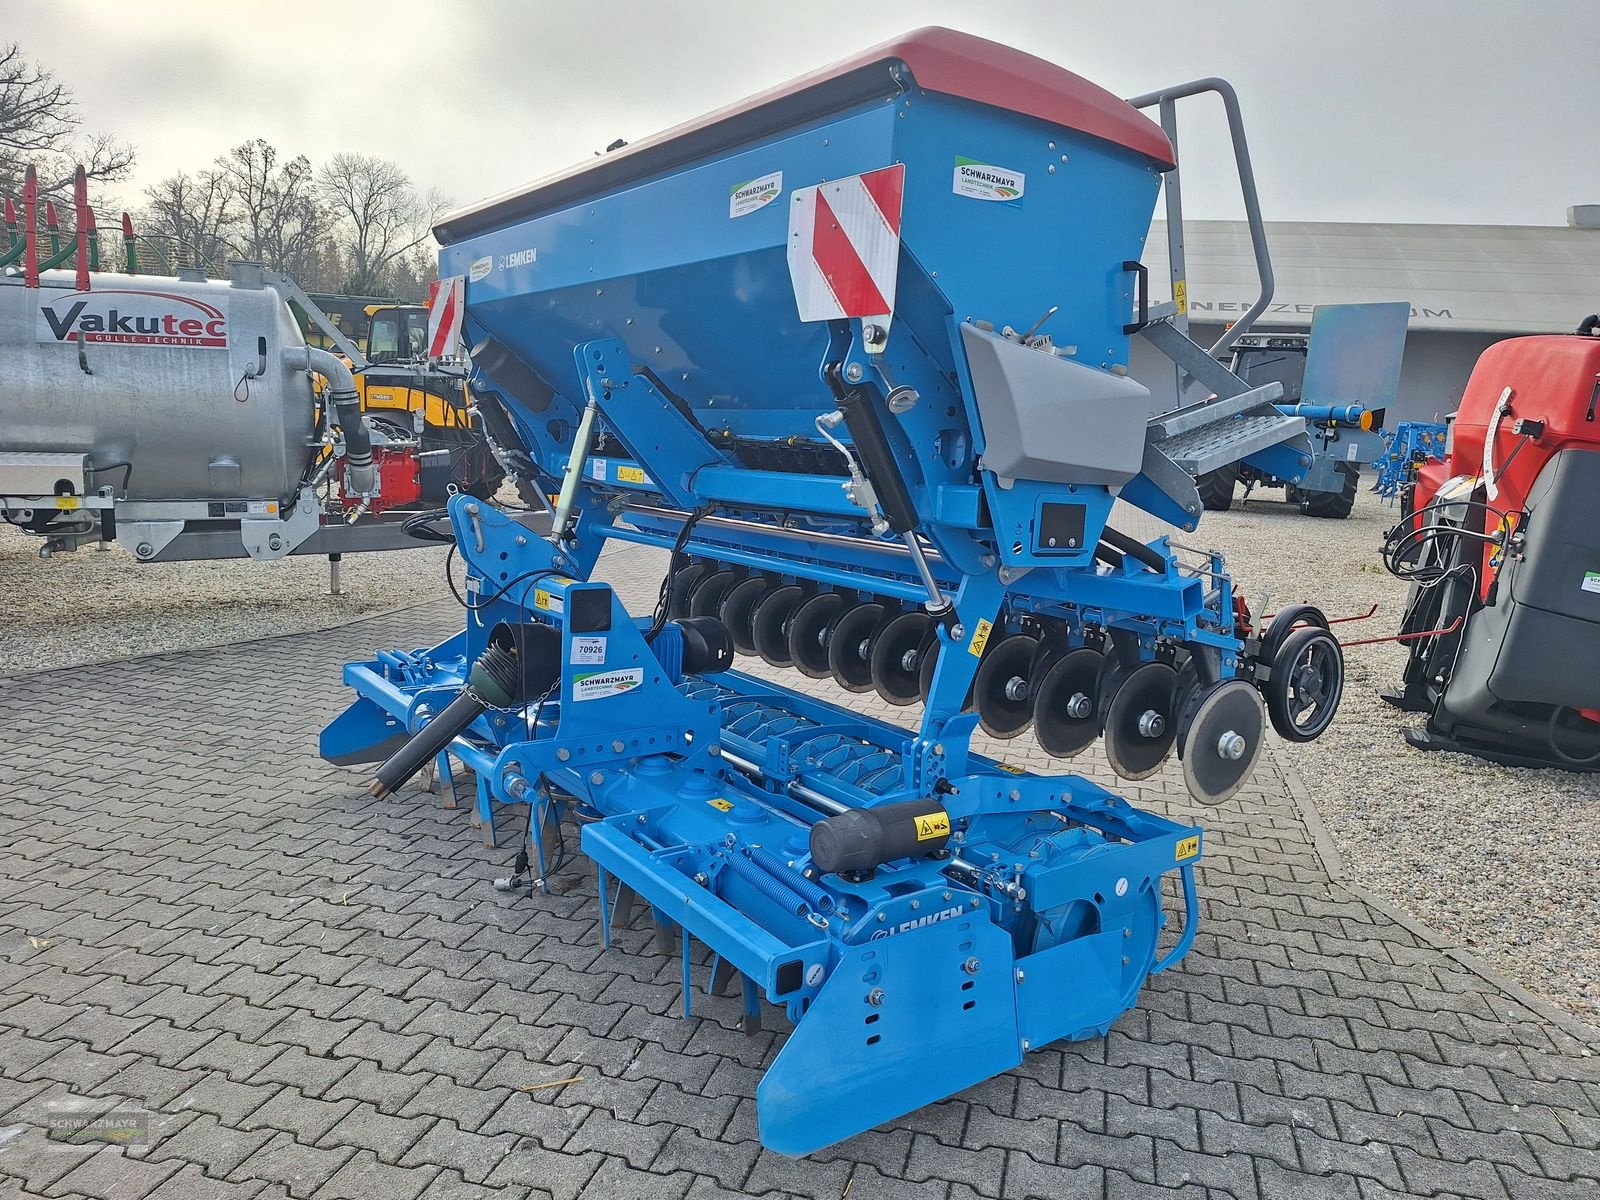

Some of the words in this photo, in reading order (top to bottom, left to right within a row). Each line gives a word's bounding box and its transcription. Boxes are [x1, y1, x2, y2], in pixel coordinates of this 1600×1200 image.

[961, 167, 1015, 187] SCHWARZMAYR
[961, 178, 993, 190] LANDTECHNIK
[735, 182, 775, 200] SCHWARZMAYR
[505, 248, 536, 269] LEMKEN
[41, 301, 227, 341] Vakutec
[579, 645, 603, 654] 70926
[580, 675, 634, 687] SCHWARZMAYR
